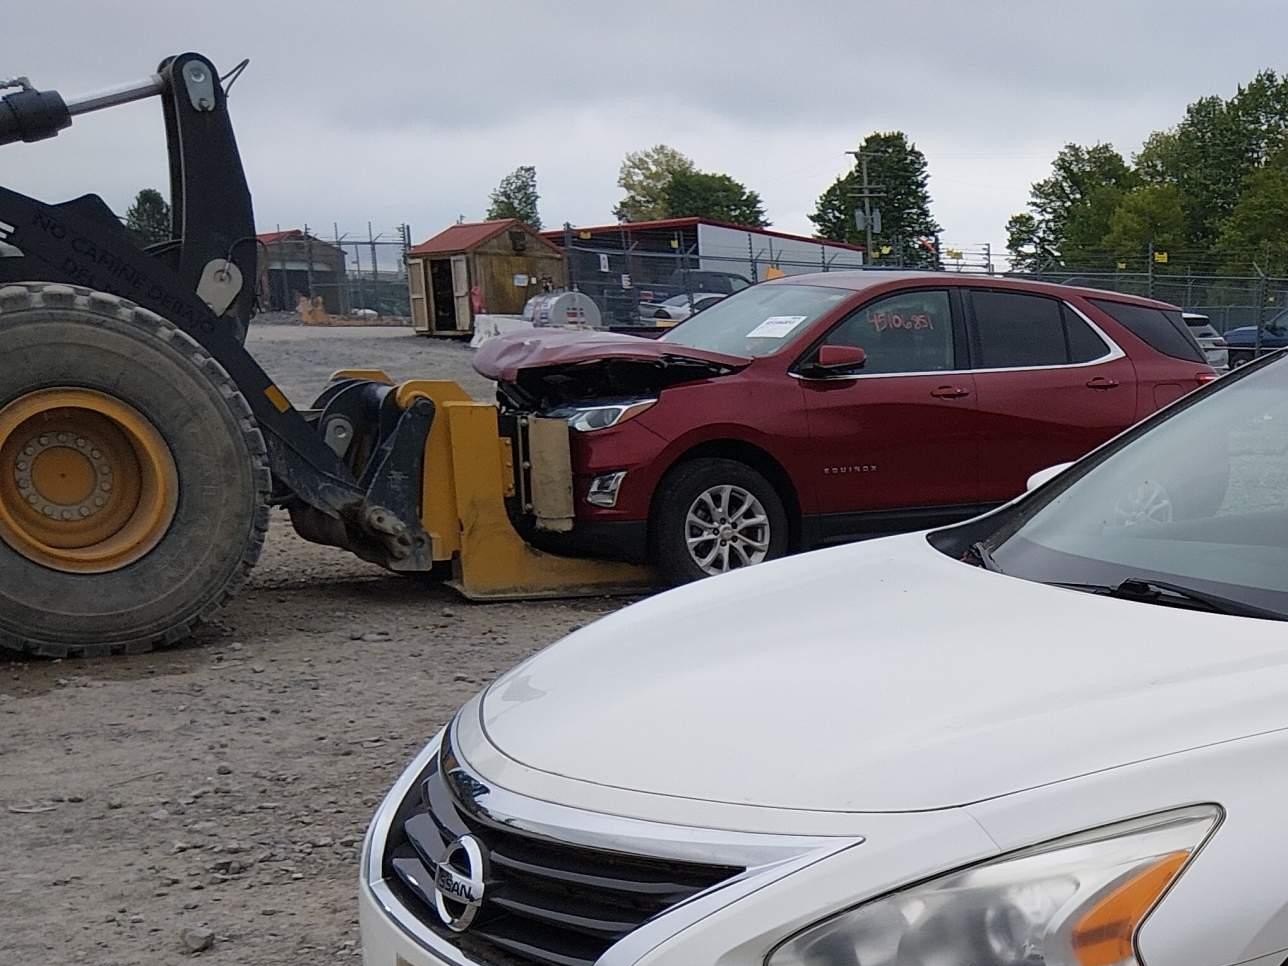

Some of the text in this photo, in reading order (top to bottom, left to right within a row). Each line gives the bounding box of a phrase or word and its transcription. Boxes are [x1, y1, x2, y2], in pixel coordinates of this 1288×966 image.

[31, 208, 67, 240] NO
[824, 465, 877, 474] EQUINOX
[437, 873, 473, 900] SSAN
